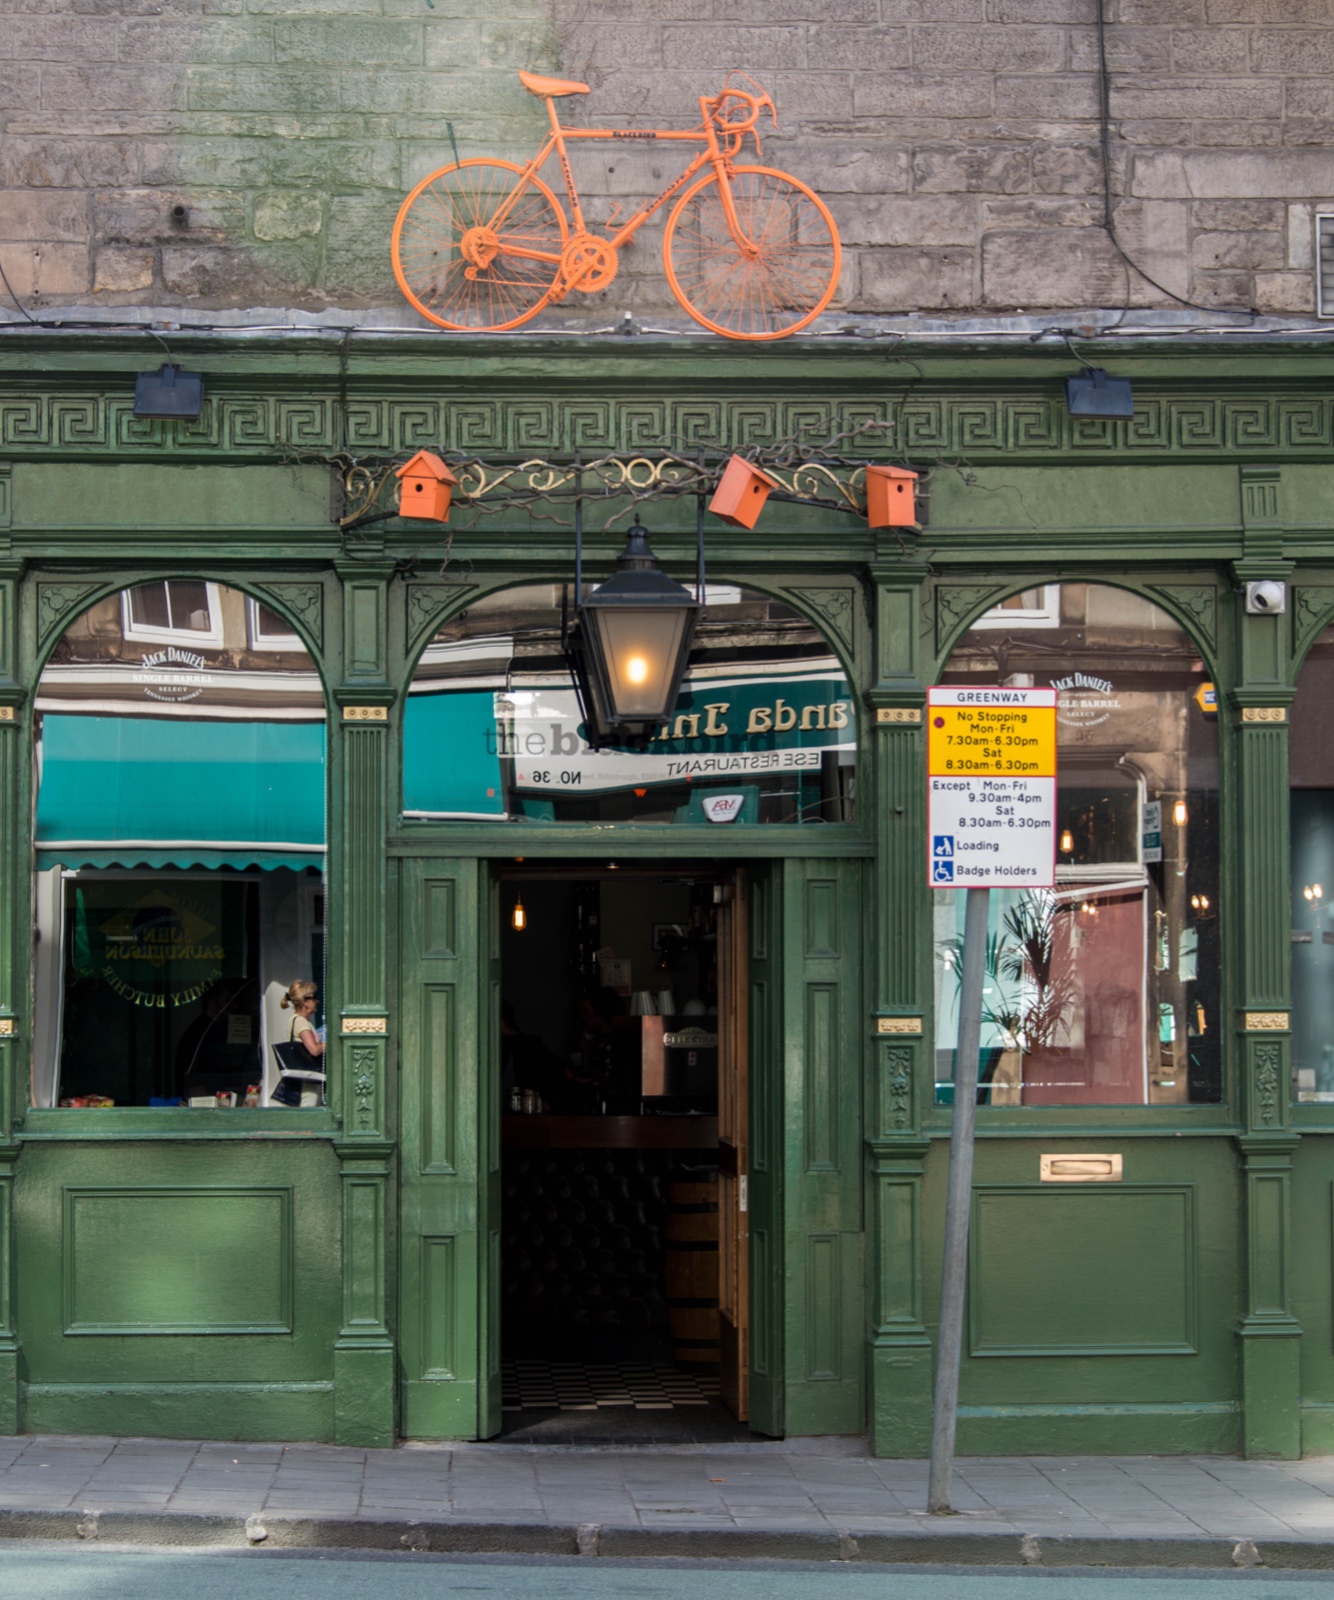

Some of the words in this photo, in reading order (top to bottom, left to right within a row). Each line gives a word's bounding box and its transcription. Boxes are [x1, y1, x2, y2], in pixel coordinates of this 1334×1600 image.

[142, 651, 168, 670] JACK
[168, 646, 206, 671] DANIEL'S
[132, 674, 172, 682] SINGLE
[172, 674, 215, 684] BARREL
[1074, 672, 1114, 696] DANIEL'S
[143, 687, 176, 702] TENNESSEE
[176, 688, 204, 702] WHISKEY
[956, 692, 1028, 702] GREENWAY
[1080, 700, 1121, 708] BARREL
[957, 712, 974, 721] No
[977, 712, 1028, 724] Stopping
[970, 724, 1014, 734] Mon-Fri
[946, 736, 1039, 747] 7.30am-6.30pm
[982, 748, 1002, 758] Sat
[946, 760, 1039, 771] 8.30am-6.30pm
[932, 780, 970, 791] Except
[983, 780, 1028, 790] Mon-Fri
[968, 792, 1042, 804] 9.30am-4pm
[995, 806, 1015, 816] Sat
[958, 818, 1051, 828] 8.30am-6.30pm
[956, 841, 1000, 852] Loading
[956, 866, 990, 877] Badge
[994, 866, 1037, 876] Holders
